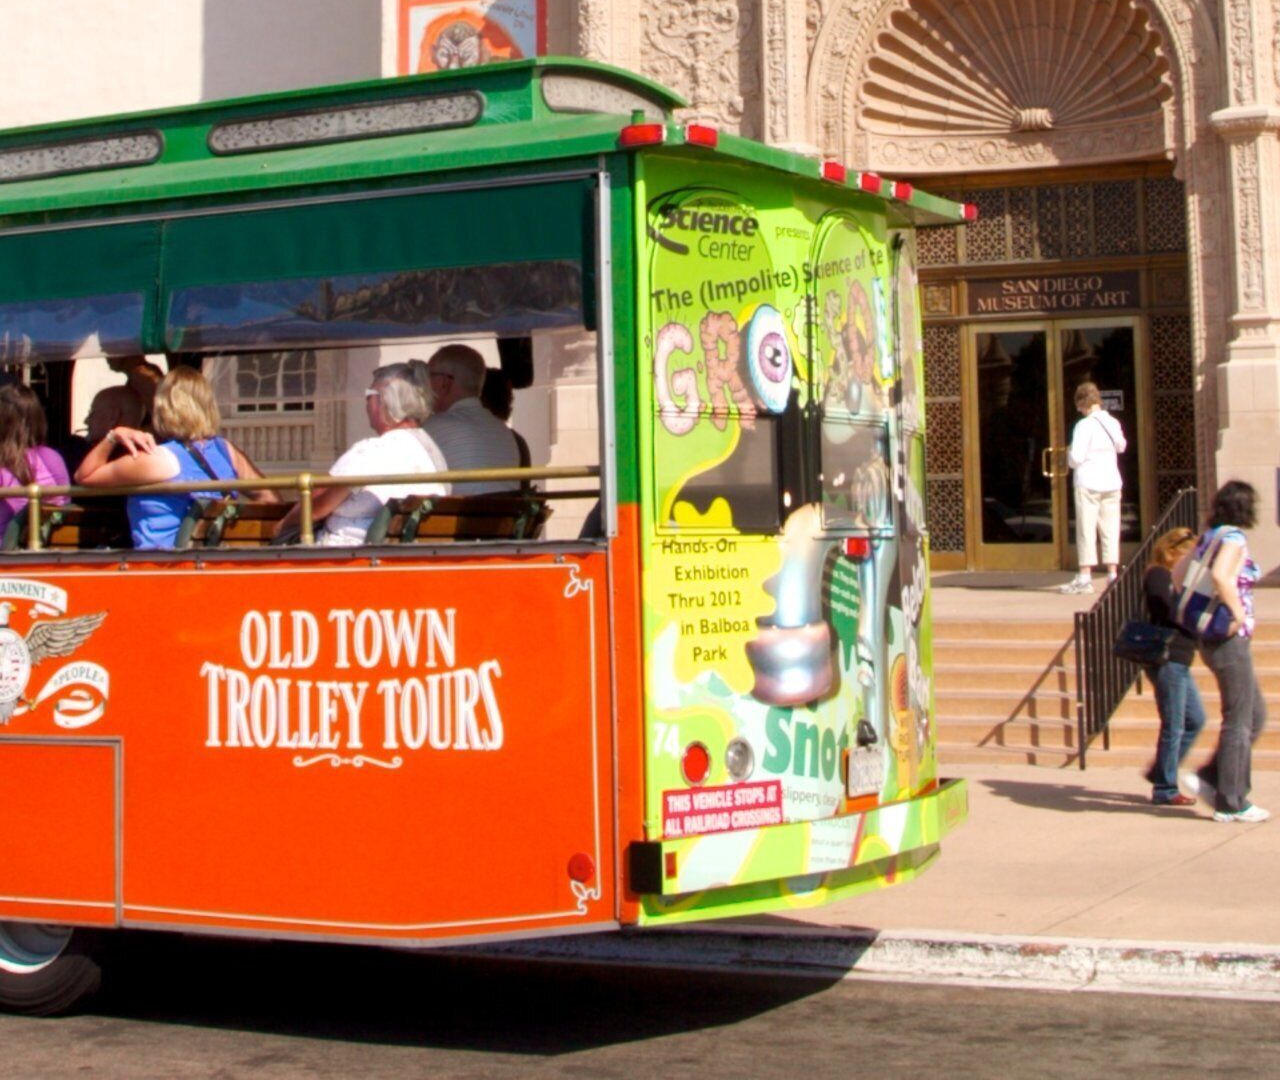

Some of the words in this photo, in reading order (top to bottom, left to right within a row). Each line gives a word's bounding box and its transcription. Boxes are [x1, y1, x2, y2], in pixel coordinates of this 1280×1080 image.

[659, 205, 760, 237] Science
[698, 234, 756, 261] Center
[651, 286, 693, 313] The
[700, 265, 800, 311] (Impolite)
[1002, 280, 1040, 295] SAN
[1043, 276, 1103, 293] DIEGO
[976, 294, 1058, 312] MUSEUM
[1060, 292, 1087, 308] OF
[1091, 290, 1131, 307] ART
[661, 538, 737, 555] Hands-On
[674, 565, 750, 581] Exhibition
[667, 592, 705, 609] Thru
[709, 590, 742, 607] 2012
[239, 610, 320, 670] OLD
[327, 608, 457, 669] TOWN
[681, 623, 694, 636] in
[700, 617, 750, 635] Balboa
[693, 644, 728, 662] Park
[59, 666, 100, 685] PEOPLE
[200, 661, 370, 749] TROLLEY
[376, 658, 504, 751] TOURS
[654, 721, 680, 759] 74
[762, 707, 849, 784] Snot
[667, 794, 692, 813] THIS
[692, 789, 734, 811] VEHICLE
[734, 786, 766, 806] STOPS
[766, 784, 778, 802] AT
[664, 818, 683, 837] ALL
[683, 812, 731, 835] RAILROAD
[731, 806, 781, 828] CROSSINGS
